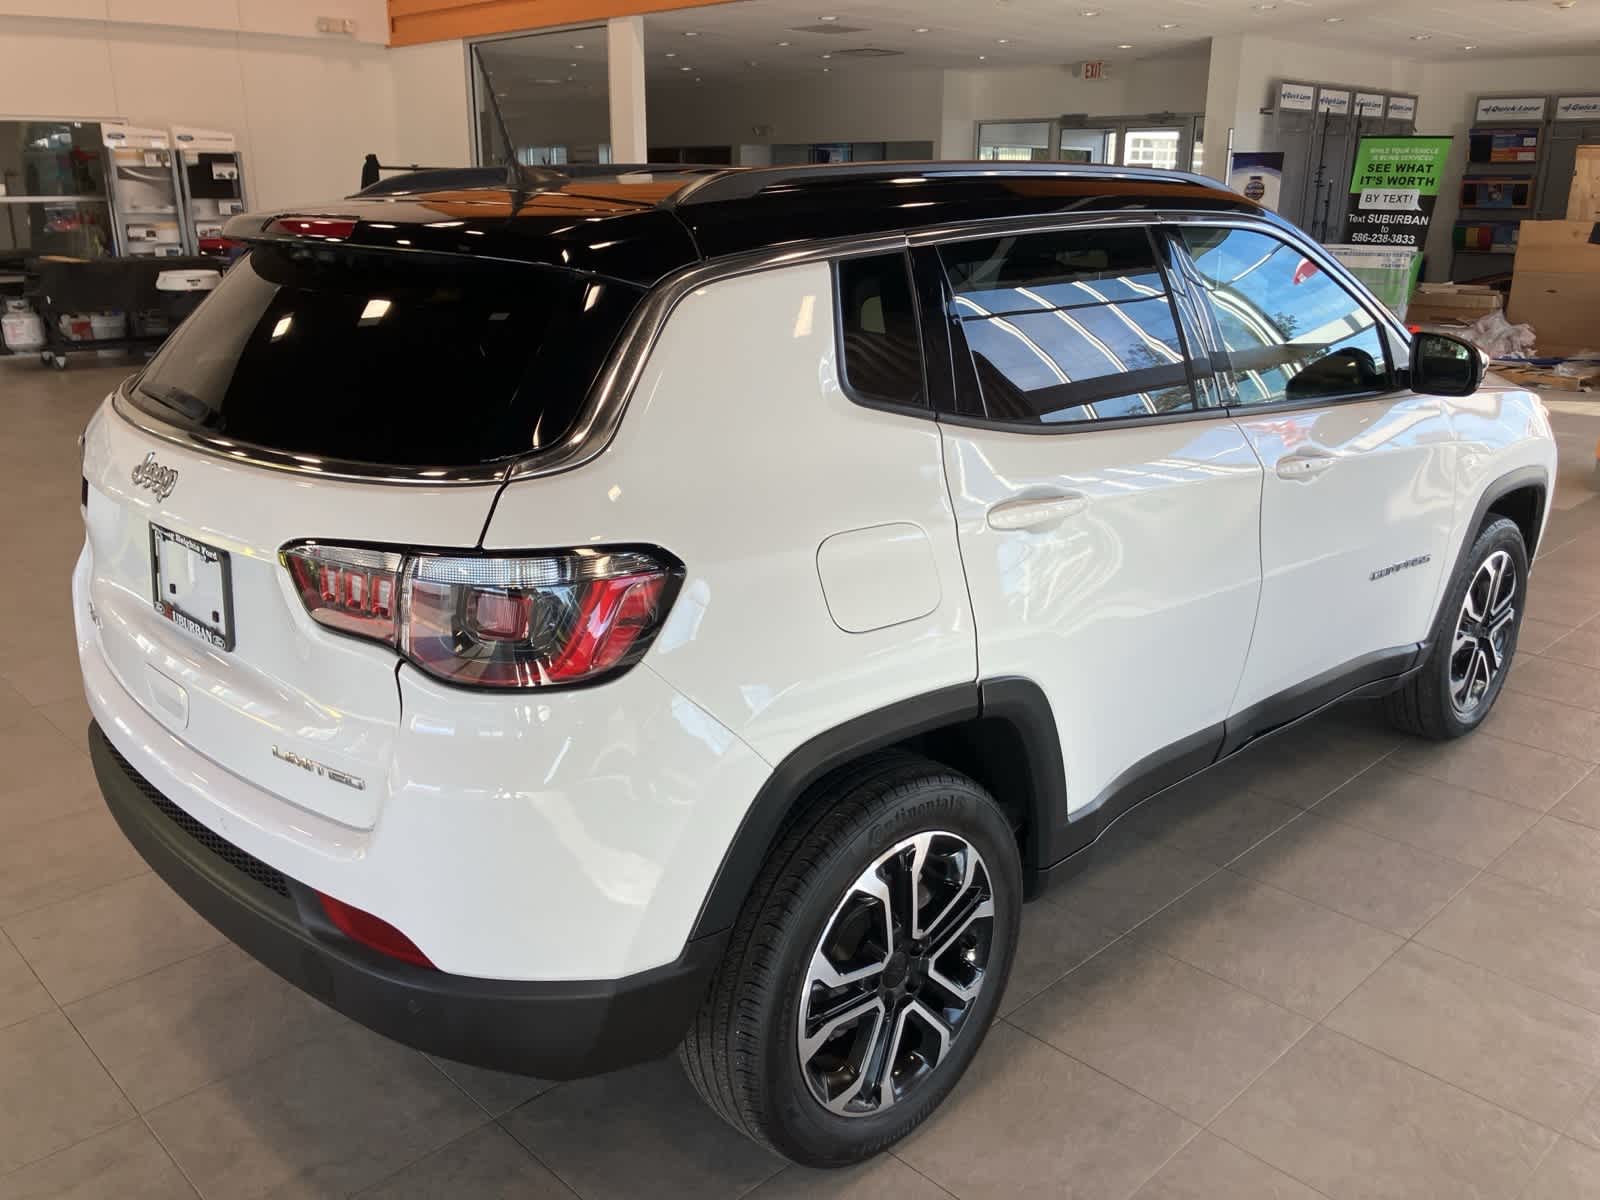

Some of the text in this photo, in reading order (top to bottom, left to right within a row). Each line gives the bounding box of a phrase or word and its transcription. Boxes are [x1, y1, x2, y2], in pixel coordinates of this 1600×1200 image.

[1085, 62, 1104, 79] EXIT
[1490, 104, 1516, 112] Quick
[1571, 103, 1597, 111] Quick
[1367, 163, 1434, 173] SEE WHAT
[1360, 175, 1435, 186] IT'S WORTH
[1364, 194, 1413, 203] BY TEXT!
[1348, 214, 1429, 225] Text SUBURBAN
[1380, 225, 1389, 233] to
[1351, 232, 1416, 244] 586-238-3833
